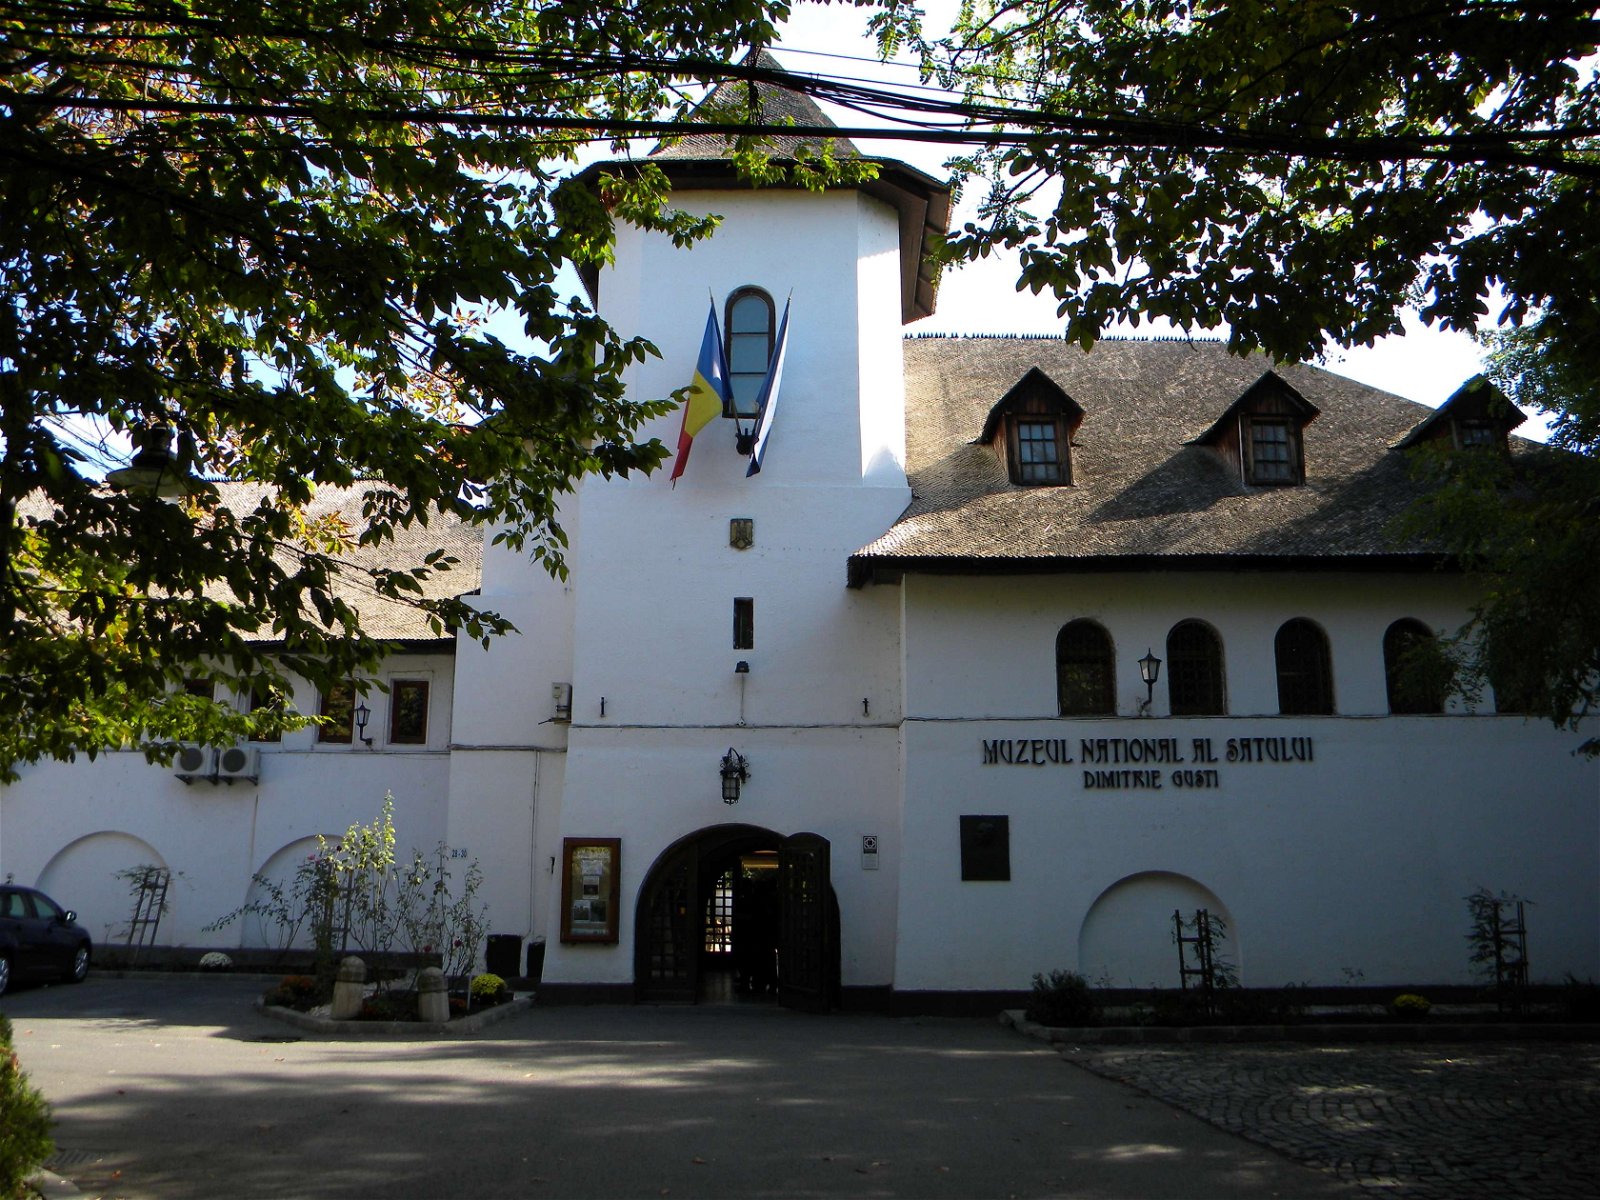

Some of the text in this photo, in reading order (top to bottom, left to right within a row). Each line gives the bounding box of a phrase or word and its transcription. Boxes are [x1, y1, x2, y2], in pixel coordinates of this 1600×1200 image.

[982, 736, 1314, 766] MUZEUL NATIONAL AL SATULUI
[1083, 769, 1220, 789] DIMITRIE GUSTI
